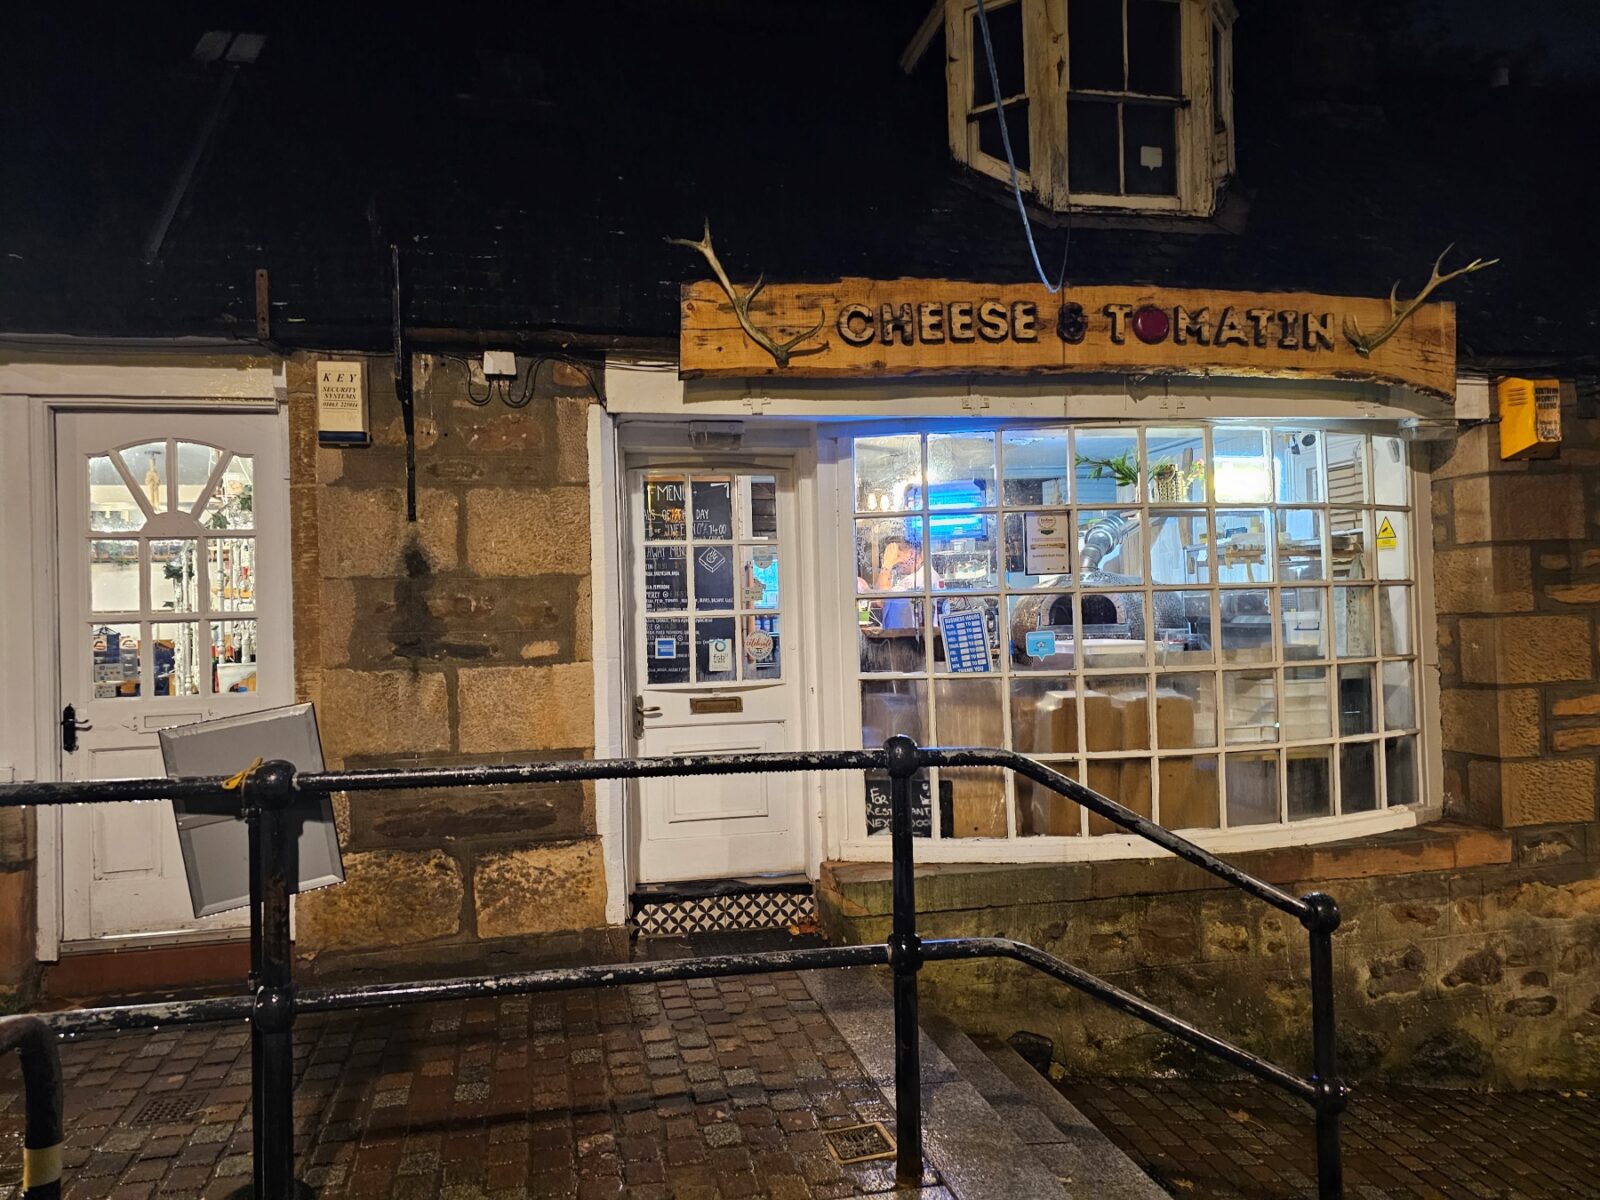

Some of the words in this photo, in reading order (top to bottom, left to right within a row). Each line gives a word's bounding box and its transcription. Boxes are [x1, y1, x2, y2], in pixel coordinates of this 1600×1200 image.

[837, 301, 1039, 347] CHEESE
[1057, 301, 1088, 345] &
[1103, 303, 1336, 352] TOMATIN
[696, 508, 710, 520] DAY
[870, 788, 889, 804] FOR
[866, 818, 893, 828] NEX
